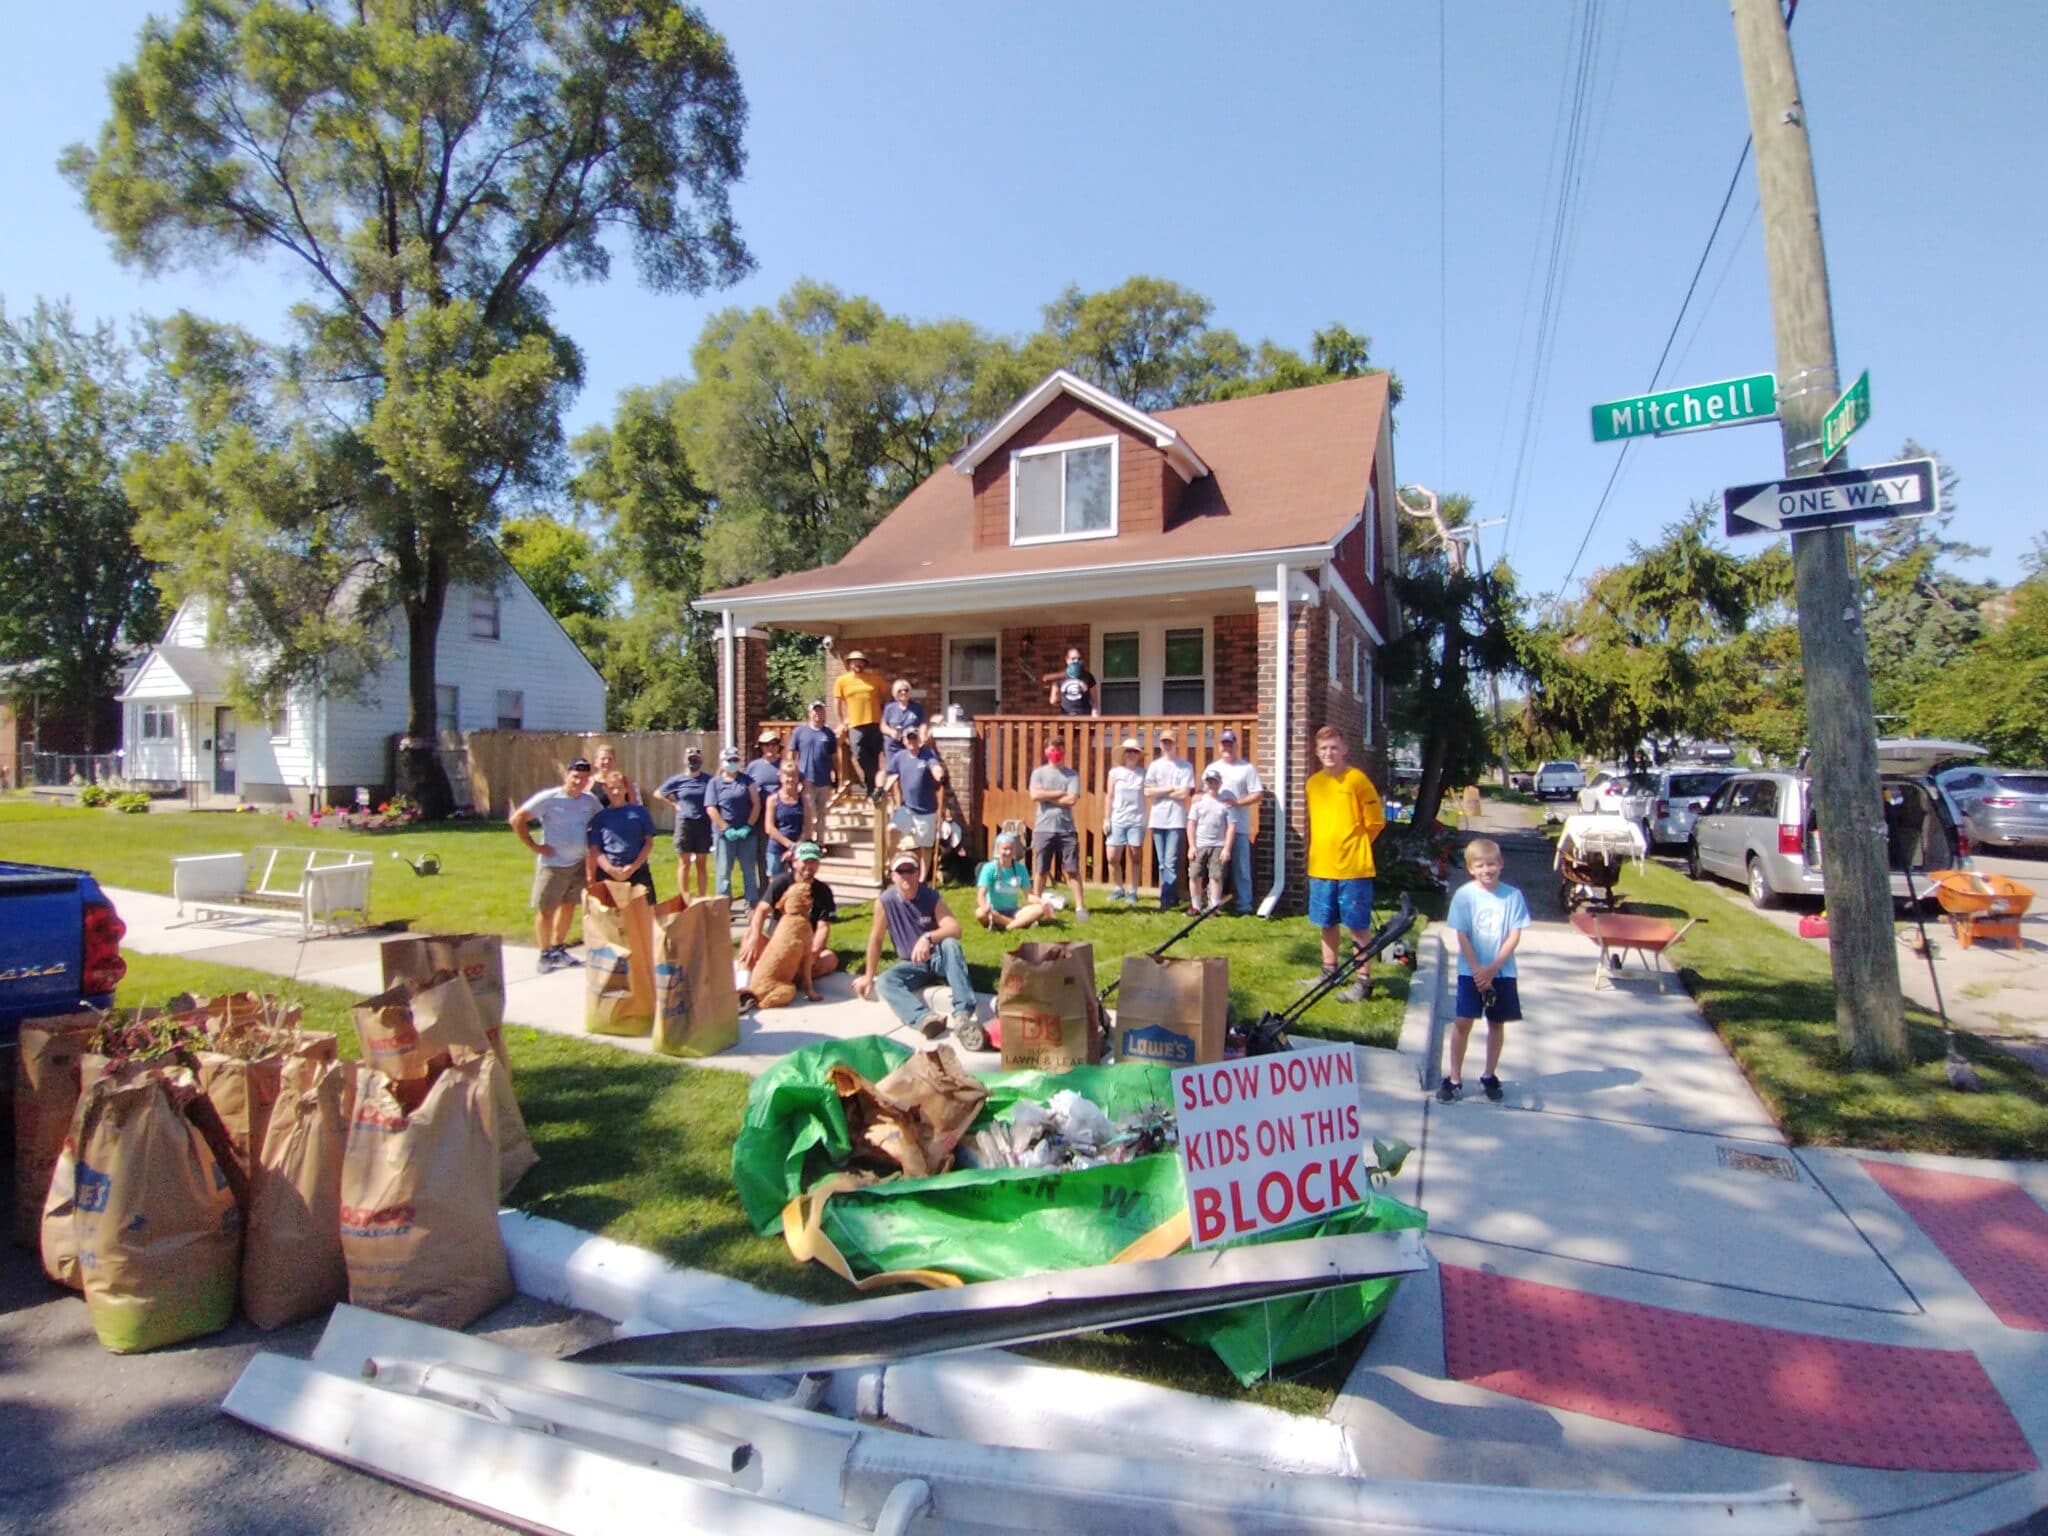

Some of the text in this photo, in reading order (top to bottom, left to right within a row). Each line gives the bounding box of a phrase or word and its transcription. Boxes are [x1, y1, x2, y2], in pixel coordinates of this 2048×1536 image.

[1611, 382, 1754, 435] Mitchell
[1778, 478, 1910, 515] ONE WAY
[1005, 1054, 1040, 1066] LAWN
[1181, 1051, 1354, 1111] SLOW DOWN
[1184, 1104, 1361, 1173] KIDS ON THIS
[1193, 1153, 1362, 1243] BLOCK
